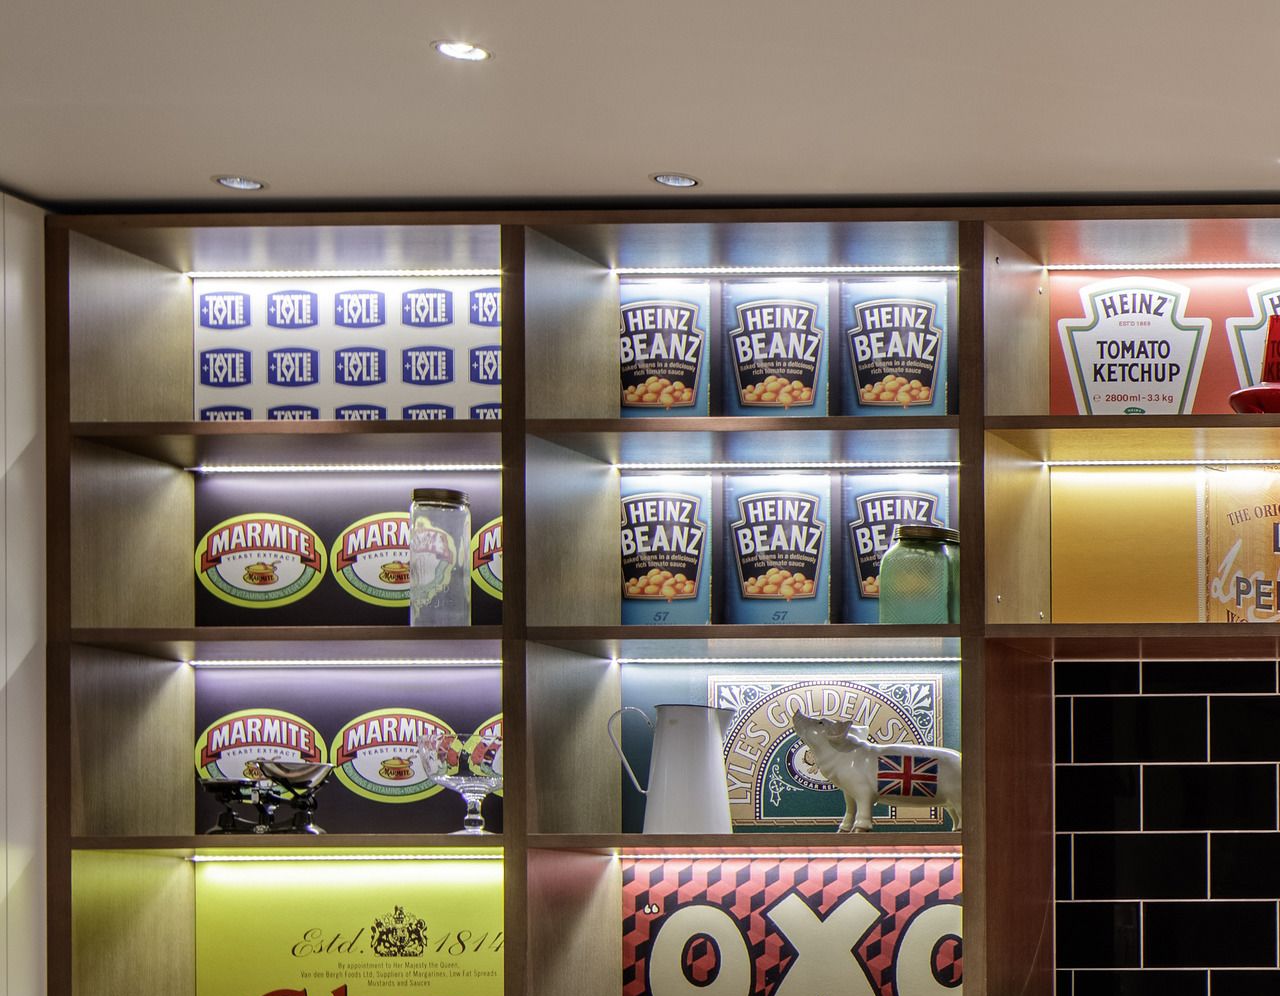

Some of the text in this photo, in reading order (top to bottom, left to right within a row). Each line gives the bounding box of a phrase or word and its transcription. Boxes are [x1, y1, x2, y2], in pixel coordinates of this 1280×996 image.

[1101, 293, 1167, 317] HEINZ
[627, 308, 690, 331] HEINZ
[746, 307, 809, 331] HEINZ
[864, 306, 928, 330] HEINZ
[341, 352, 379, 366] TATE
[620, 333, 700, 363] BEANZ
[736, 332, 820, 363] BEANZ
[854, 332, 938, 363] BEANZ
[1097, 340, 1170, 359] TOMATO
[206, 353, 244, 367] TATE
[210, 368, 244, 382] LYLE
[344, 367, 379, 381] LYLE
[1093, 363, 1181, 383] KETCHUP
[630, 500, 691, 524] HEINZ
[748, 500, 810, 523] HEINZ
[1227, 508, 1251, 526] THE
[212, 522, 311, 555] MARMITE
[737, 525, 822, 556] BEANZ
[227, 552, 295, 562] YEAST EXTRACT
[211, 718, 310, 751] MARMITE
[227, 749, 295, 757] YEAST EXTRACT
[726, 721, 771, 804] LYLE'S
